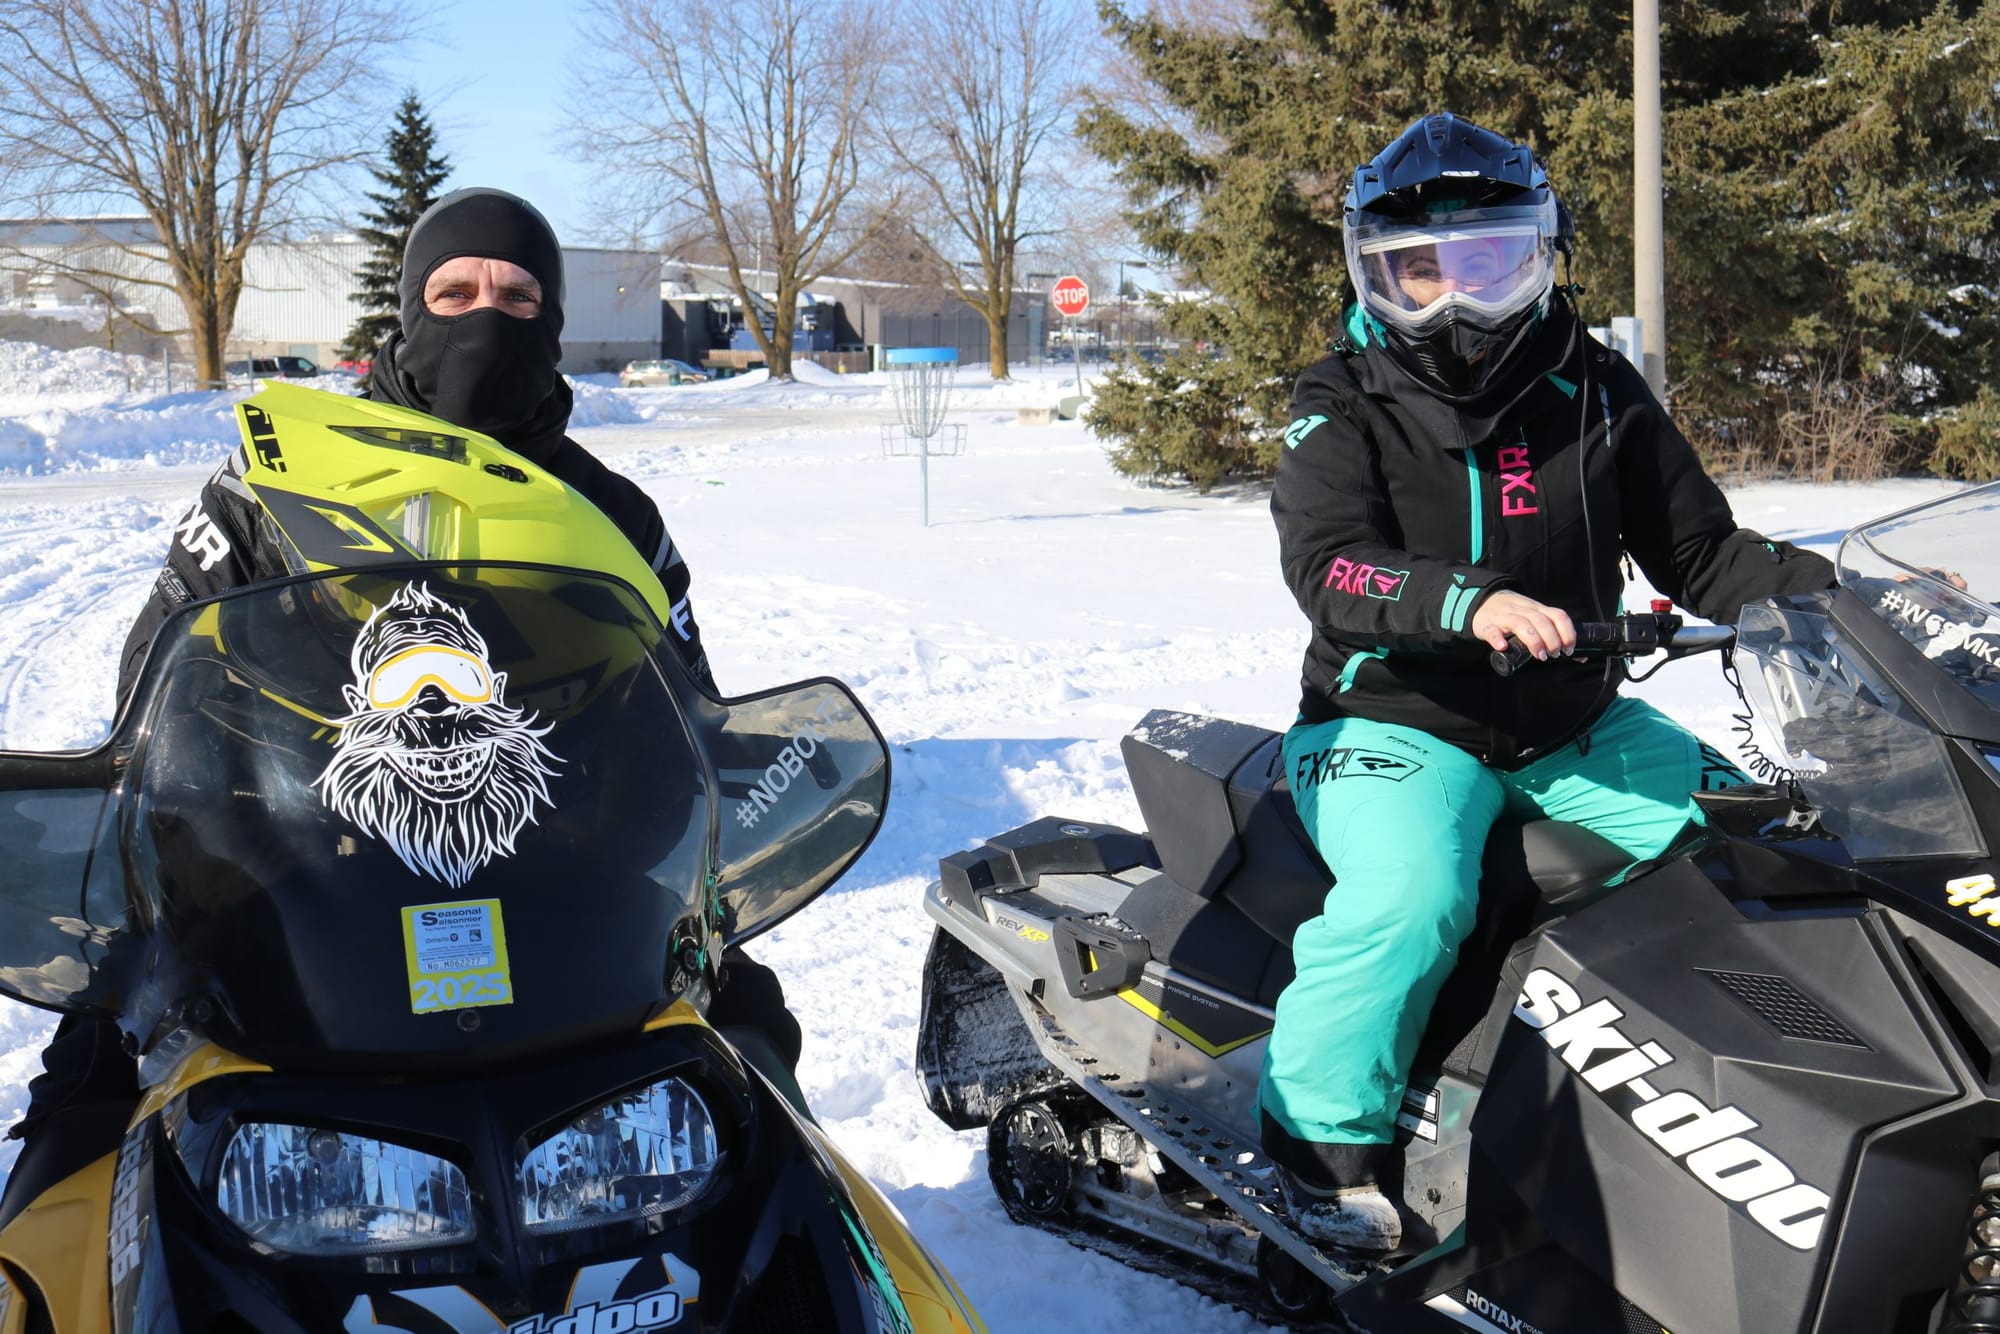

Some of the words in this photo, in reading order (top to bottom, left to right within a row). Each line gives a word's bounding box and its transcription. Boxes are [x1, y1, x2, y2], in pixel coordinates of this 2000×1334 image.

[1055, 287, 1087, 305] STOP
[1497, 446, 1539, 517] FXR
[1325, 556, 1375, 596] FXR
[1296, 747, 1352, 792] FXR
[421, 907, 482, 926] Seasonal
[413, 972, 509, 1010] 2025
[1191, 993, 1220, 1010] SYSTEM
[1466, 1288, 1523, 1334] ROTAX
